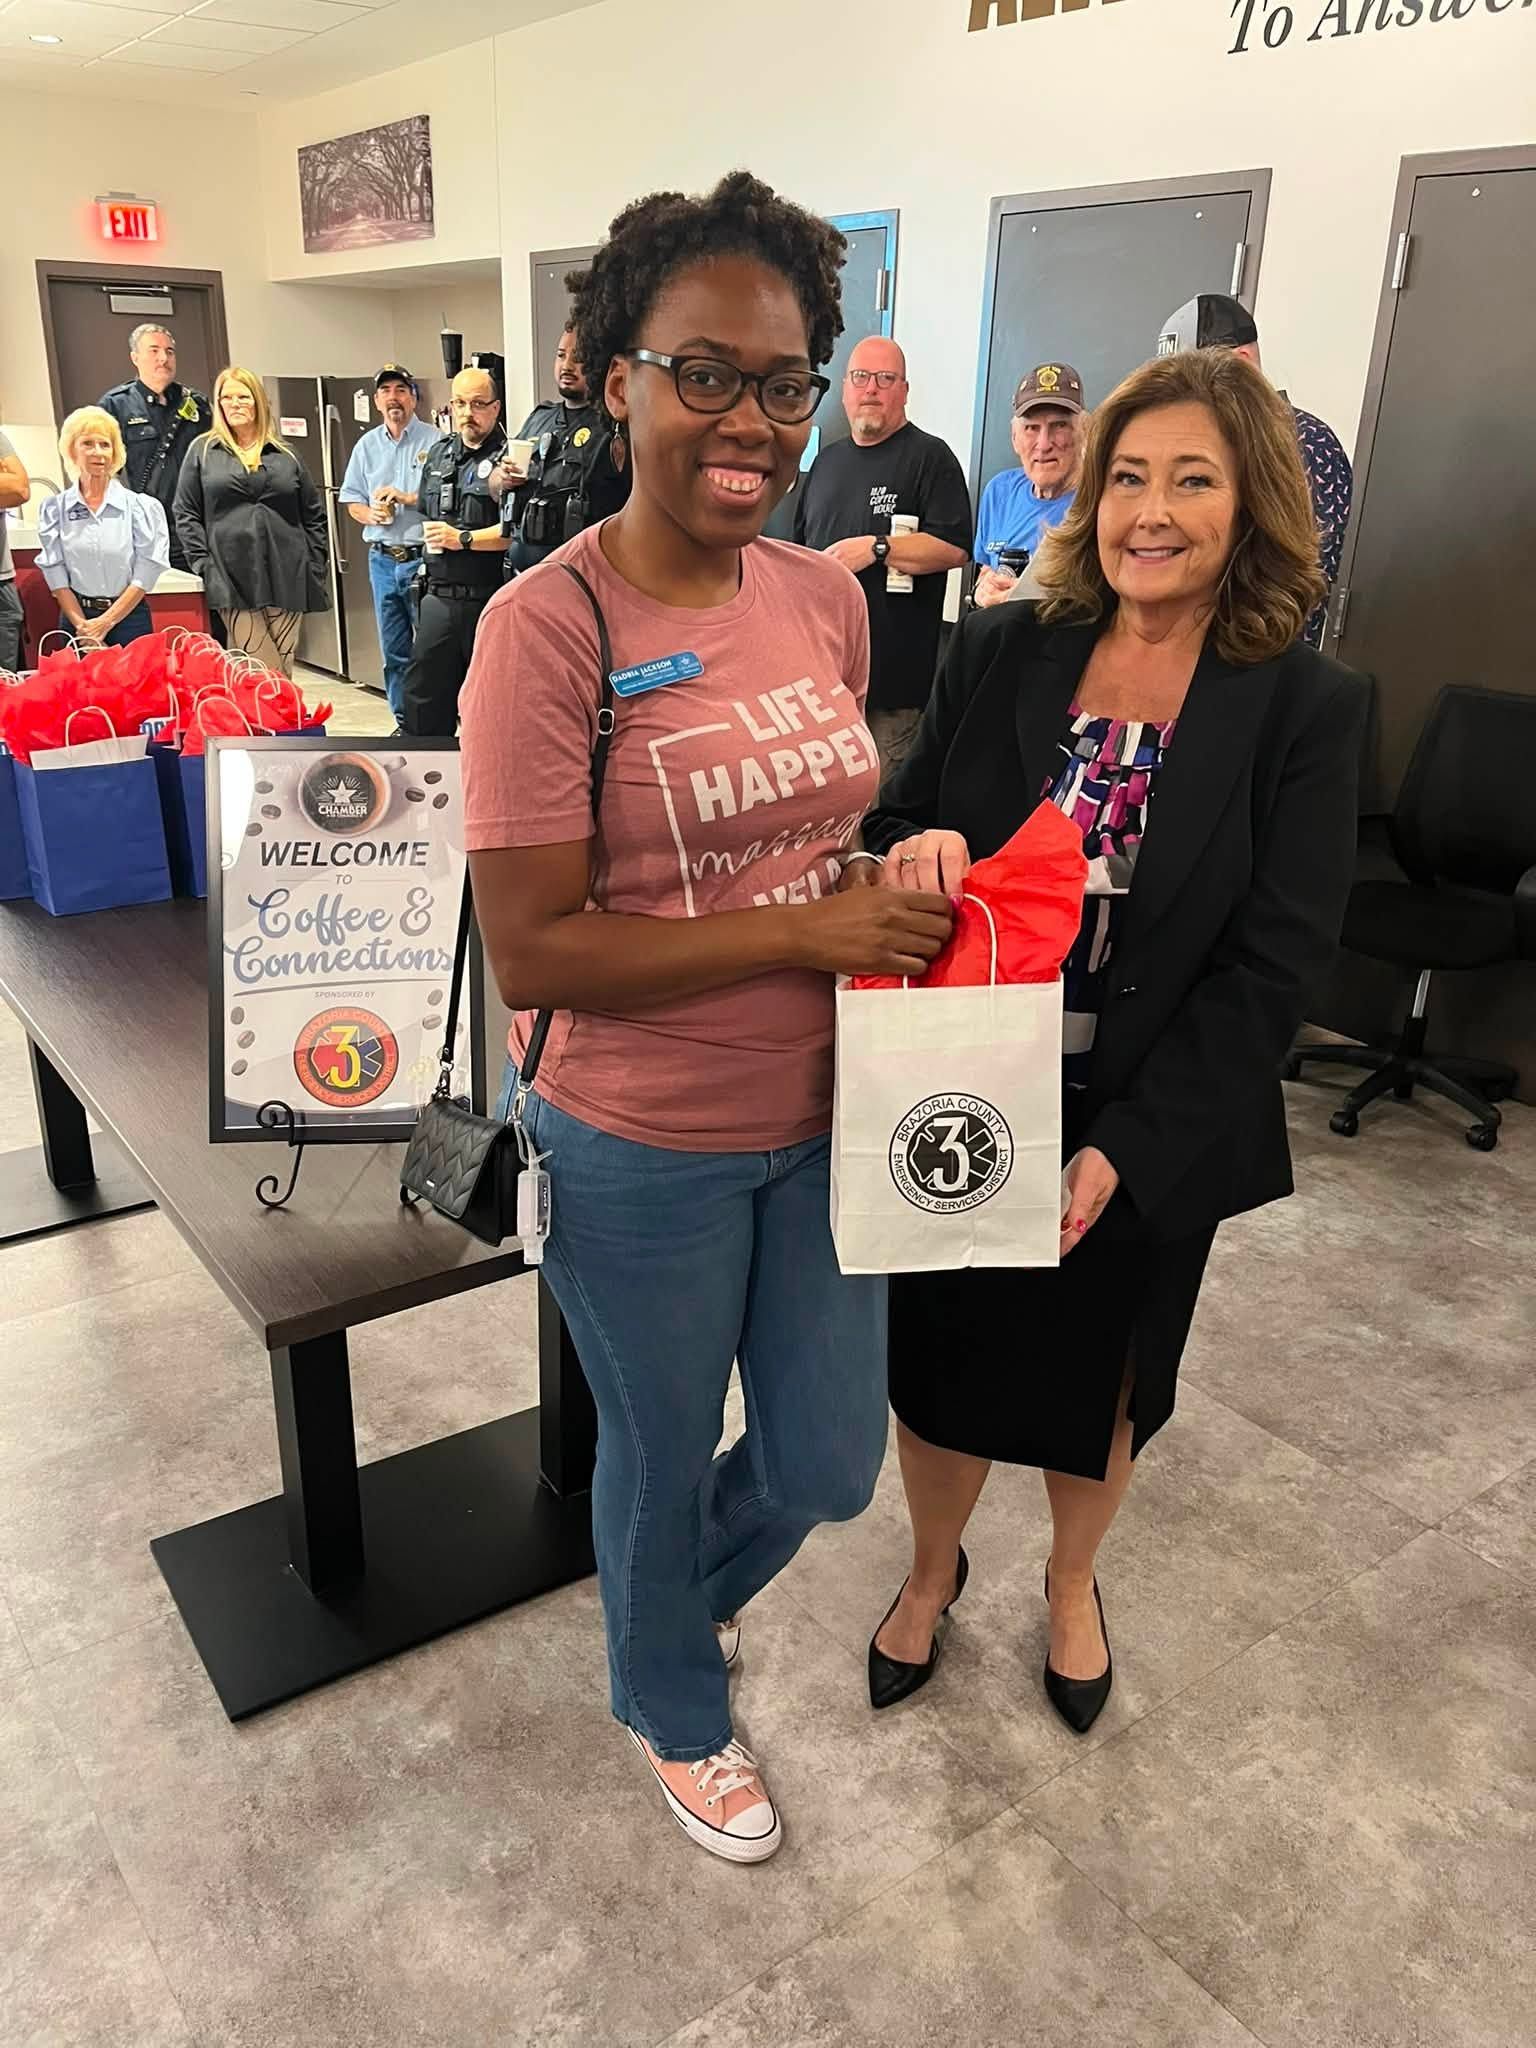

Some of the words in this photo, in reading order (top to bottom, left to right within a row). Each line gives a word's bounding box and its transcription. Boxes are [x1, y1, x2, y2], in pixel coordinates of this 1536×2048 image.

[1227, 0, 1294, 54] To
[1307, 0, 1536, 42] Answ
[109, 207, 148, 238] EXIT
[640, 660, 672, 676] JACKSON
[732, 676, 837, 742] LIFE
[318, 805, 368, 815] CHAMBER
[260, 841, 430, 867] WELCOME
[335, 874, 353, 885] TO
[247, 888, 394, 946] Coffee
[399, 886, 435, 937] &
[222, 936, 454, 984] Connections
[330, 1026, 361, 1088] 3
[896, 1097, 956, 1142] BRAZORIA
[957, 1098, 1006, 1136] COUNTY
[933, 1116, 970, 1192] 3
[894, 1153, 934, 1207] EMERGENCY
[933, 1190, 986, 1210] SERVICES
[983, 1148, 1009, 1193] DISTRICT
